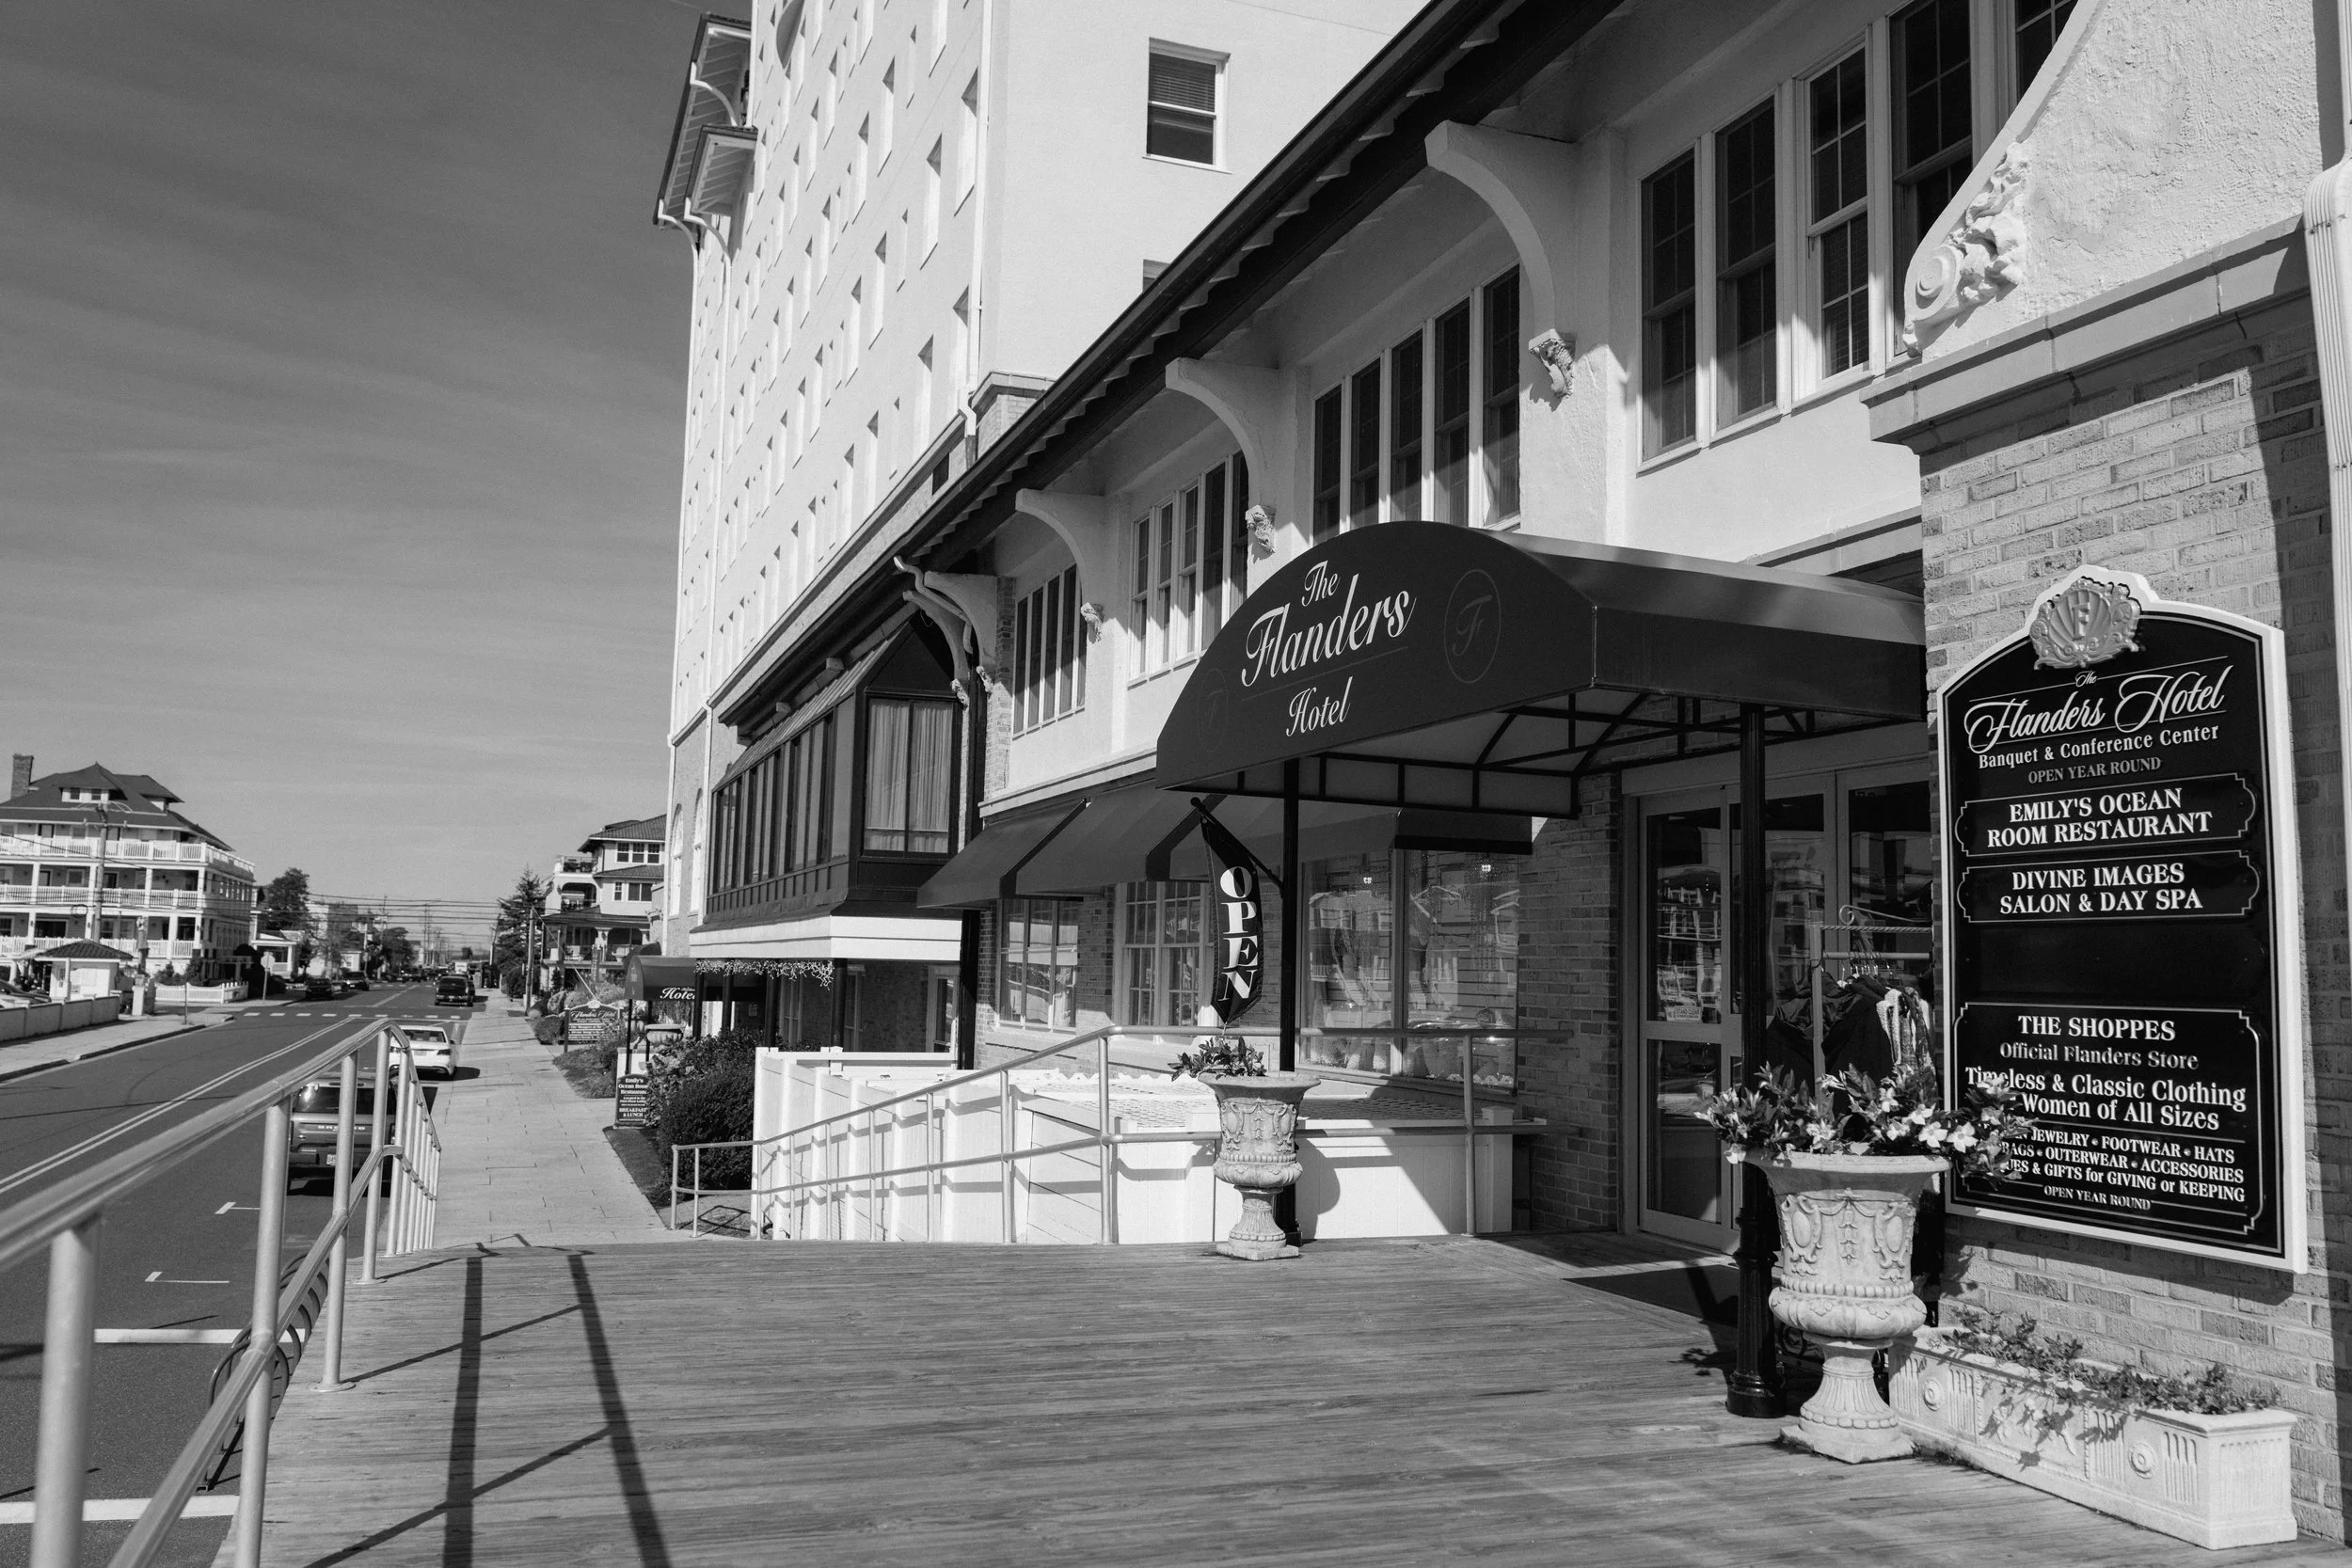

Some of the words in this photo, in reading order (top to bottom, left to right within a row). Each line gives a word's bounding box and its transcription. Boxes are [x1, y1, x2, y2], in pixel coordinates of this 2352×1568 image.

[1301, 560, 1341, 607] The
[1241, 573, 1417, 688] Flanders
[2074, 671, 2098, 688] The
[1286, 675, 1353, 736] Hotel
[1963, 691, 2106, 753] Flanders
[2114, 665, 2234, 734] Hotel
[1979, 750, 2039, 768] Banquet
[2044, 746, 2056, 760] &
[2060, 735, 2153, 759] Conference
[2159, 725, 2219, 746] Center
[2028, 768, 2064, 784] OPEN
[2069, 763, 2107, 779] YEAR
[2109, 756, 2162, 775] ROUND
[2010, 797, 2092, 823] EMILY'S
[2099, 787, 2183, 815] OCEAN
[1987, 825, 2048, 847] ROOM
[2054, 811, 2213, 843] RESTAURANT
[2012, 867, 2087, 891] DIVINE
[2094, 863, 2185, 886] IMAGES
[2000, 894, 2071, 914] SALON
[2078, 893, 2092, 911] &
[2100, 890, 2149, 911] DAY
[2155, 887, 2203, 910] SPA
[1218, 866, 1259, 1001] OPEN
[2018, 1015, 2061, 1036] THE
[2068, 1017, 2176, 1041] SHOPPES
[1999, 1042, 2058, 1062] Official
[2063, 1045, 2141, 1067] Flanders
[2147, 1050, 2199, 1070] Store
[2052, 1073, 2066, 1093] &
[2072, 1074, 2145, 1101] Classic
[2152, 1080, 2247, 1112] Clothing
[2021, 1092, 2091, 1119] Women
[2097, 1098, 2117, 1121] of
[2123, 1101, 2153, 1126] All
[2160, 1105, 2219, 1131] Sizes
[1999, 1141, 2034, 1157] BAGS
[2045, 1147, 2128, 1169] OUTERWEAR
[2140, 1160, 2244, 1183] ACCESSORIES
[2031, 1128, 2090, 1147] JEWELRY
[2101, 1135, 2181, 1158] FOOTWEAR
[2194, 1144, 2234, 1164] HATS
[2032, 1162, 2041, 1175] &
[2044, 1163, 2082, 1180] GIFTS
[2086, 1167, 2104, 1182] for
[2106, 1171, 2156, 1191] GIVING
[2160, 1179, 2175, 1193] or
[2179, 1180, 2245, 1202] KEEPING
[2044, 1185, 2073, 1199] OPEN
[2076, 1190, 2107, 1204] YEAR
[2109, 1194, 2151, 1211] ROUND
